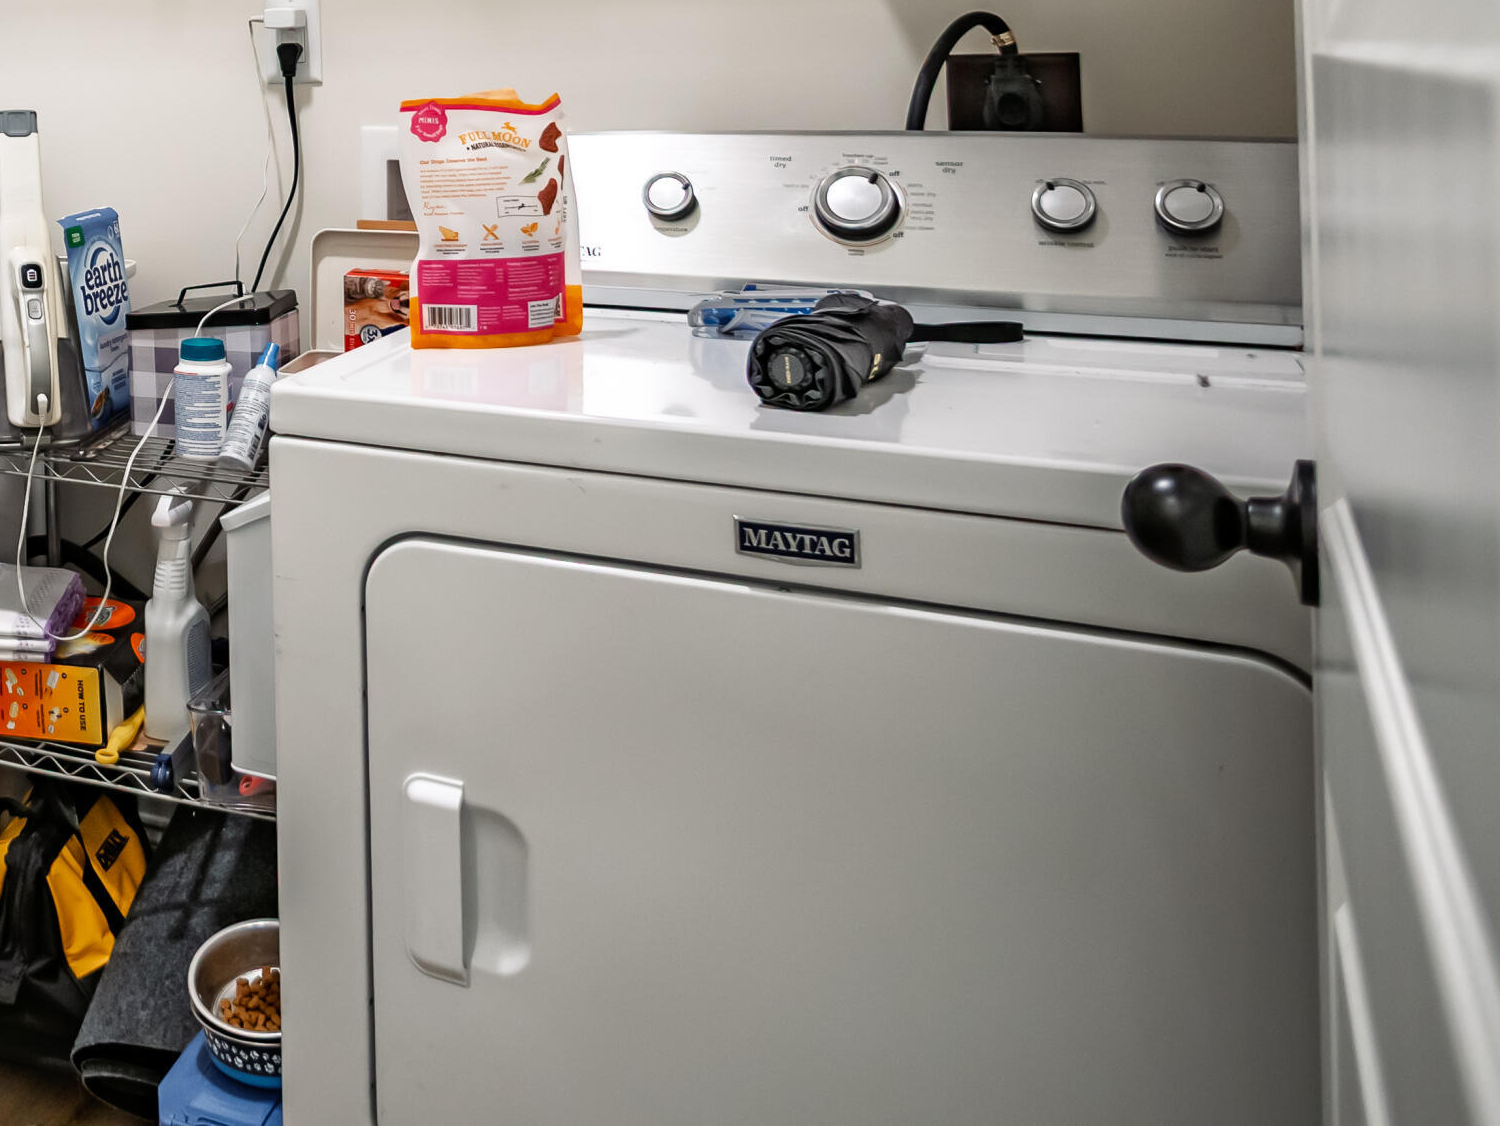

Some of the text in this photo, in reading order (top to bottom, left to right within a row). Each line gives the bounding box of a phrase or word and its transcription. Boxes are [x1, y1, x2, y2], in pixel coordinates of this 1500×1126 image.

[418, 117, 439, 125] MINIS
[458, 131, 491, 145] FULL
[492, 132, 532, 148] MOON
[85, 253, 123, 290] earth
[80, 280, 129, 316] breeze
[743, 527, 851, 558] MAYTAG
[77, 680, 85, 700] HOW
[78, 702, 86, 714] TO
